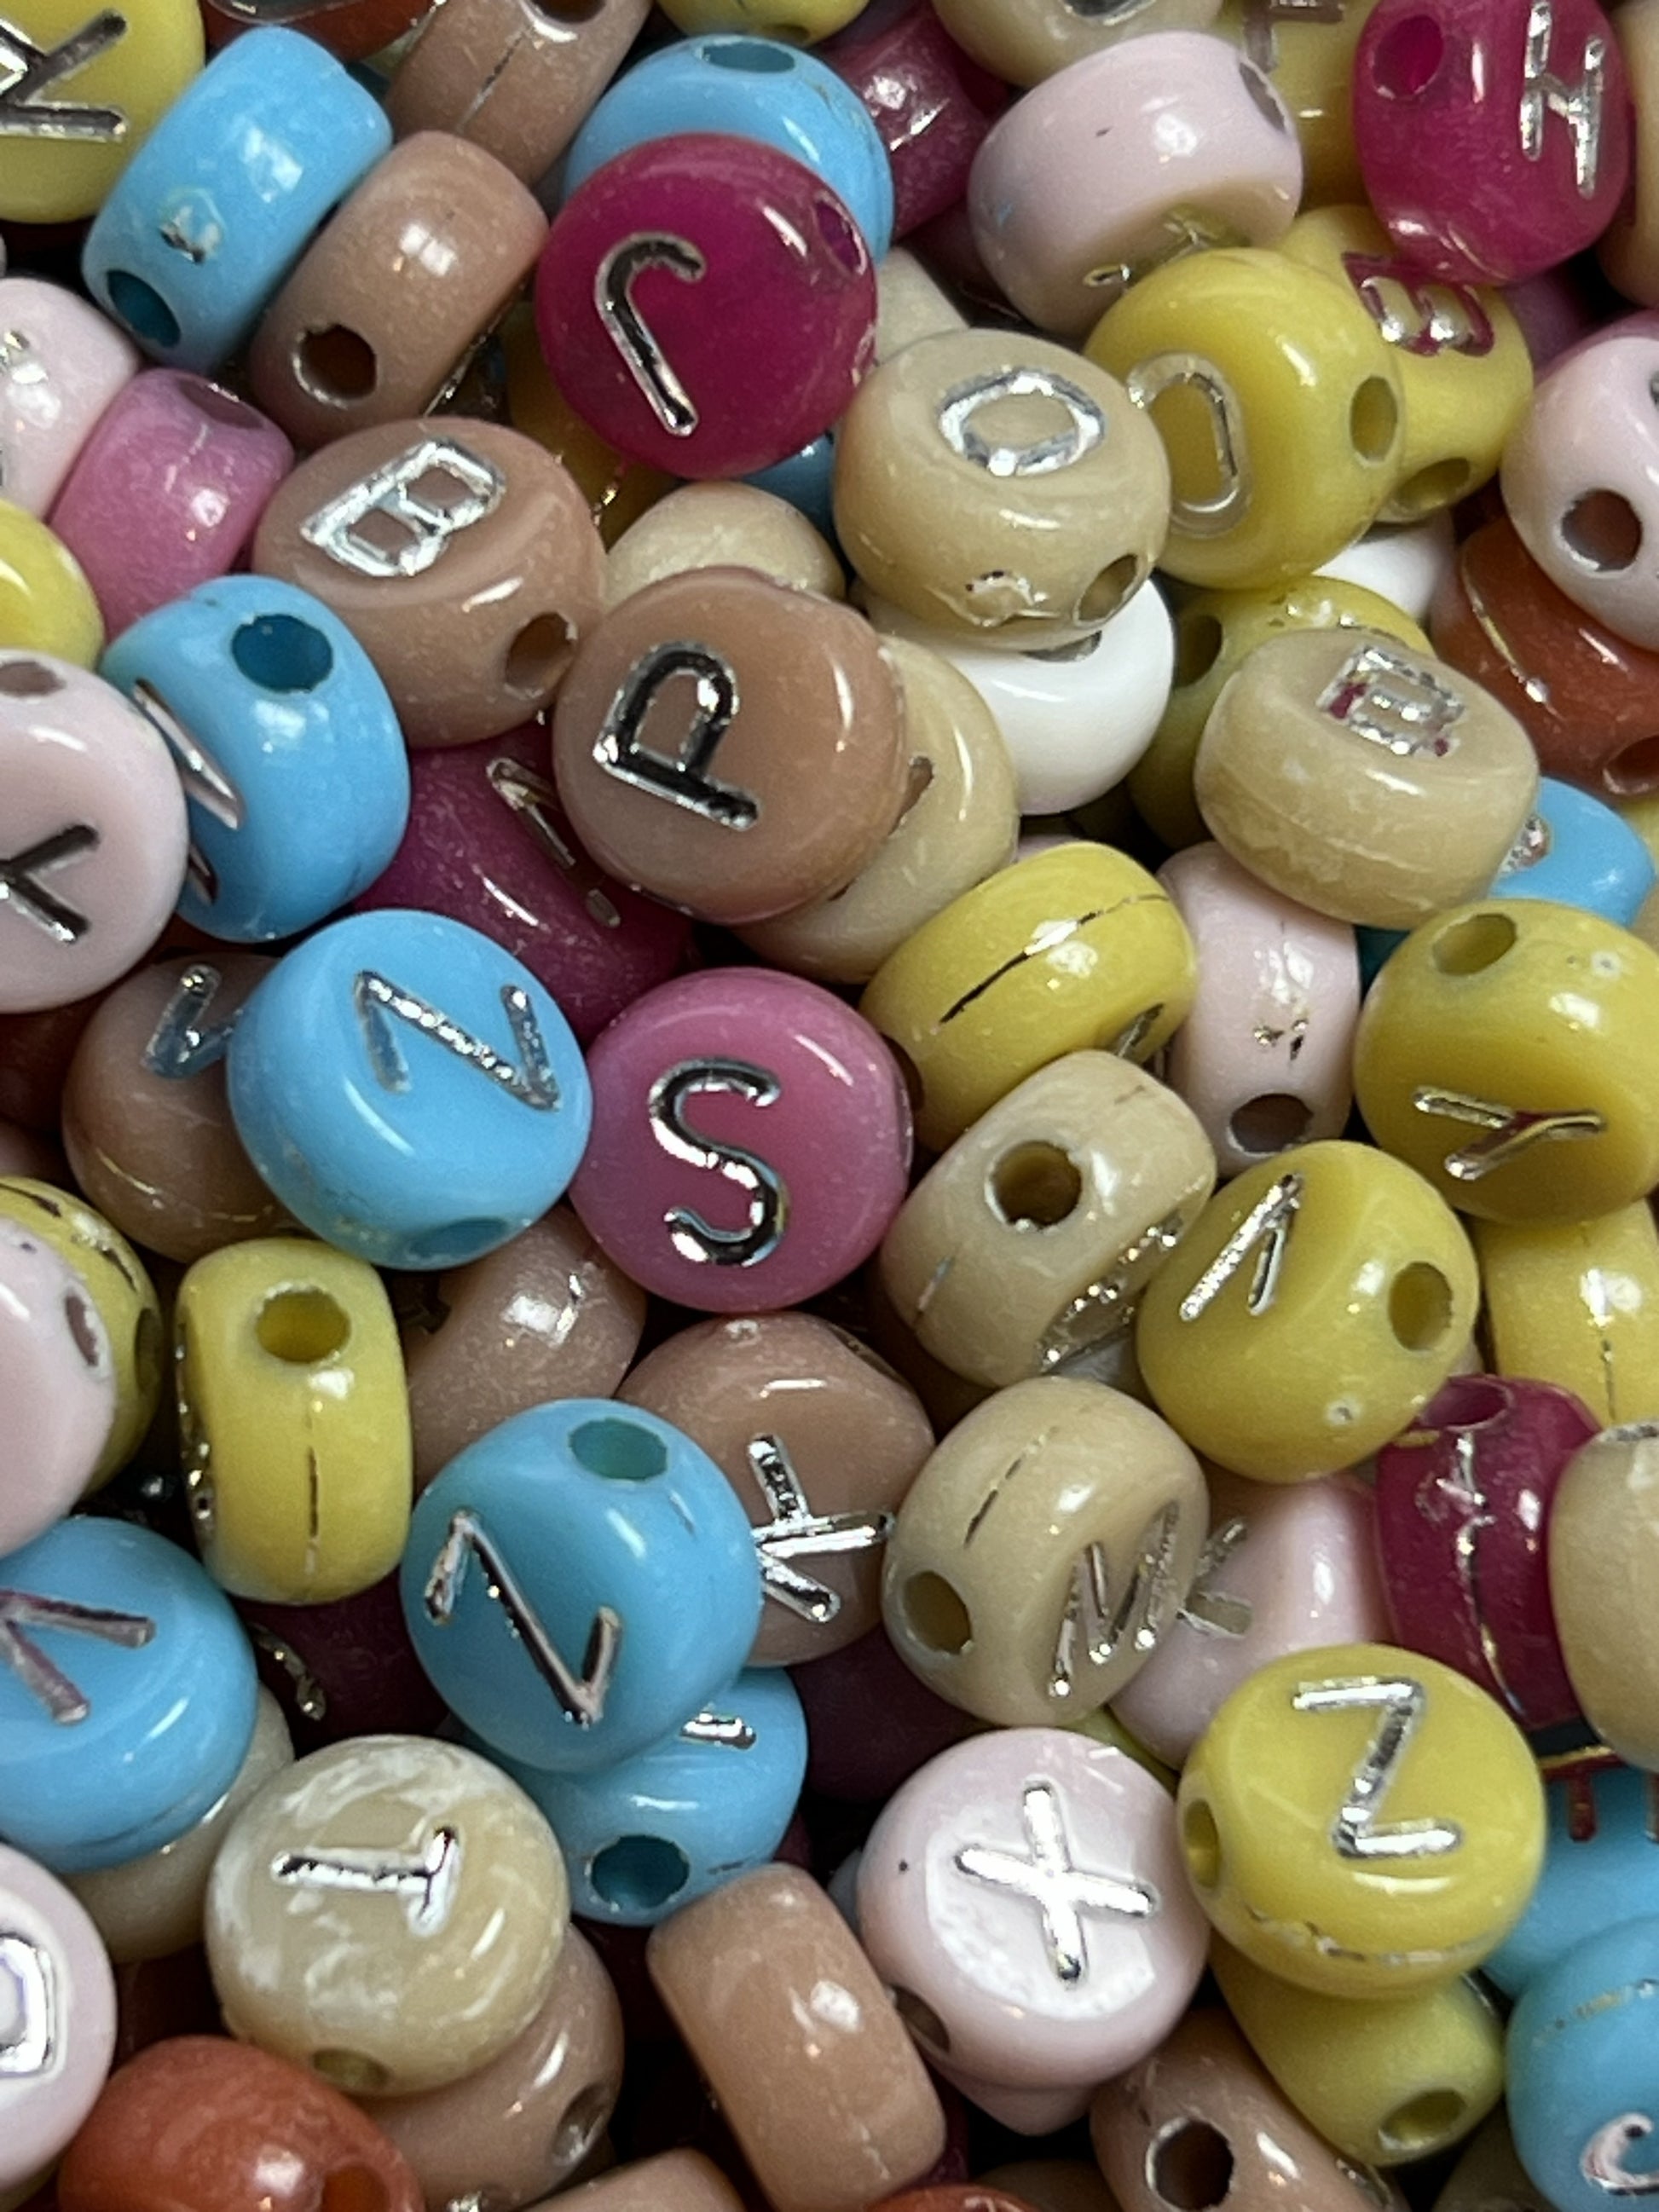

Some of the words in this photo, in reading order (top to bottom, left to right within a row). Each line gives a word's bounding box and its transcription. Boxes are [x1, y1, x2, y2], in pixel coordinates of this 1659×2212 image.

[1518, 3, 1607, 199] H
[298, 436, 506, 577] B
[592, 639, 760, 831] P
[648, 1055, 791, 1268] S
[1412, 1085, 1610, 1181] Y
[1292, 1675, 1465, 1861] Z
[270, 1824, 462, 1939] T
[953, 1773, 1160, 1990] X
